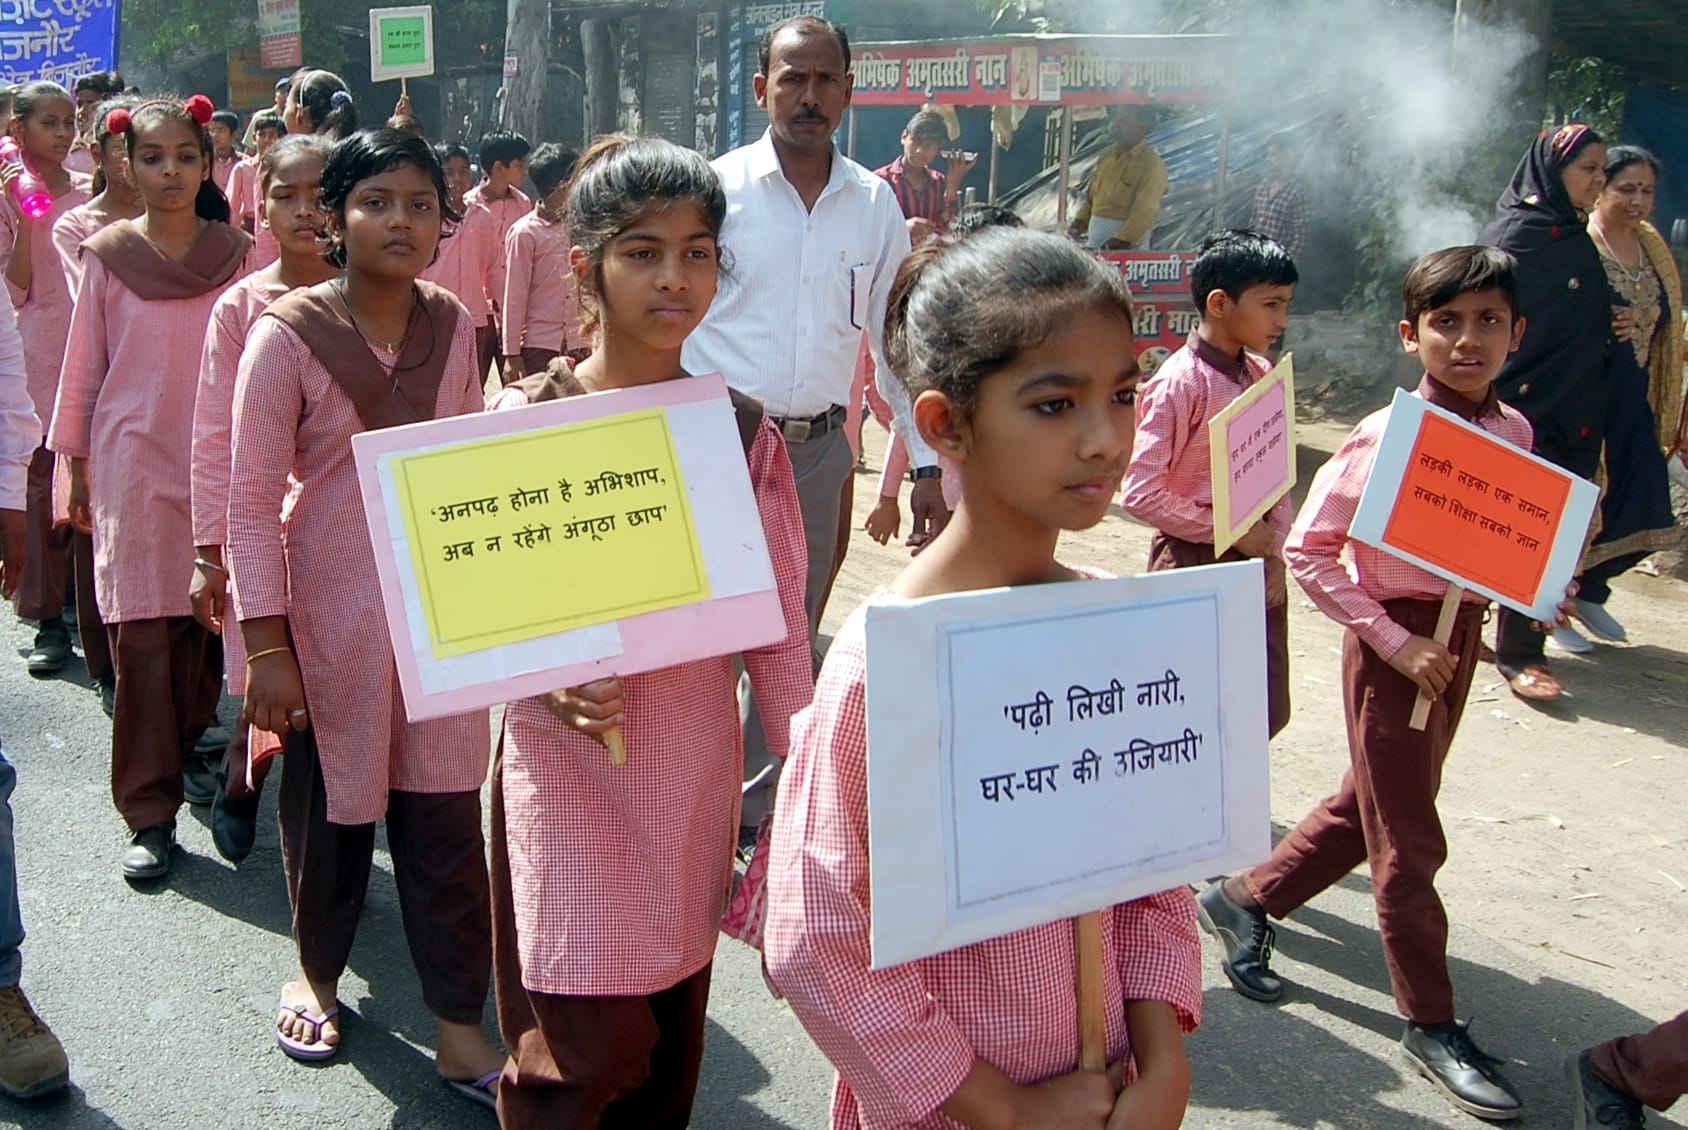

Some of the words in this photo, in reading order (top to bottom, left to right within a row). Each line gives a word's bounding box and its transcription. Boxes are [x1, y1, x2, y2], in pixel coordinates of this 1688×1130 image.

[850, 52, 901, 88] अभिषेक
[906, 48, 970, 97] अमृतसरी
[974, 54, 1007, 87] नान
[1125, 254, 1182, 287] अमृतसरी
[509, 487, 549, 512] होना
[558, 479, 572, 503] है
[584, 467, 666, 497] अभिशाप,
[1414, 485, 1447, 510] सबको
[1449, 498, 1478, 523] शिक्षा
[1480, 515, 1512, 539] सबको
[1420, 453, 1453, 477] लड़की
[1458, 470, 1490, 494] लड़का
[1494, 487, 1514, 504] एक
[1518, 498, 1550, 525] समान,
[443, 541, 474, 562] अब
[485, 536, 501, 552] न
[512, 523, 551, 549] रहेंगे
[563, 516, 616, 541] अंगूठा
[1067, 678, 1125, 722] लिखी
[1137, 669, 1185, 706] नारी,
[980, 764, 1060, 802] घर-घर
[1072, 748, 1102, 784] की
